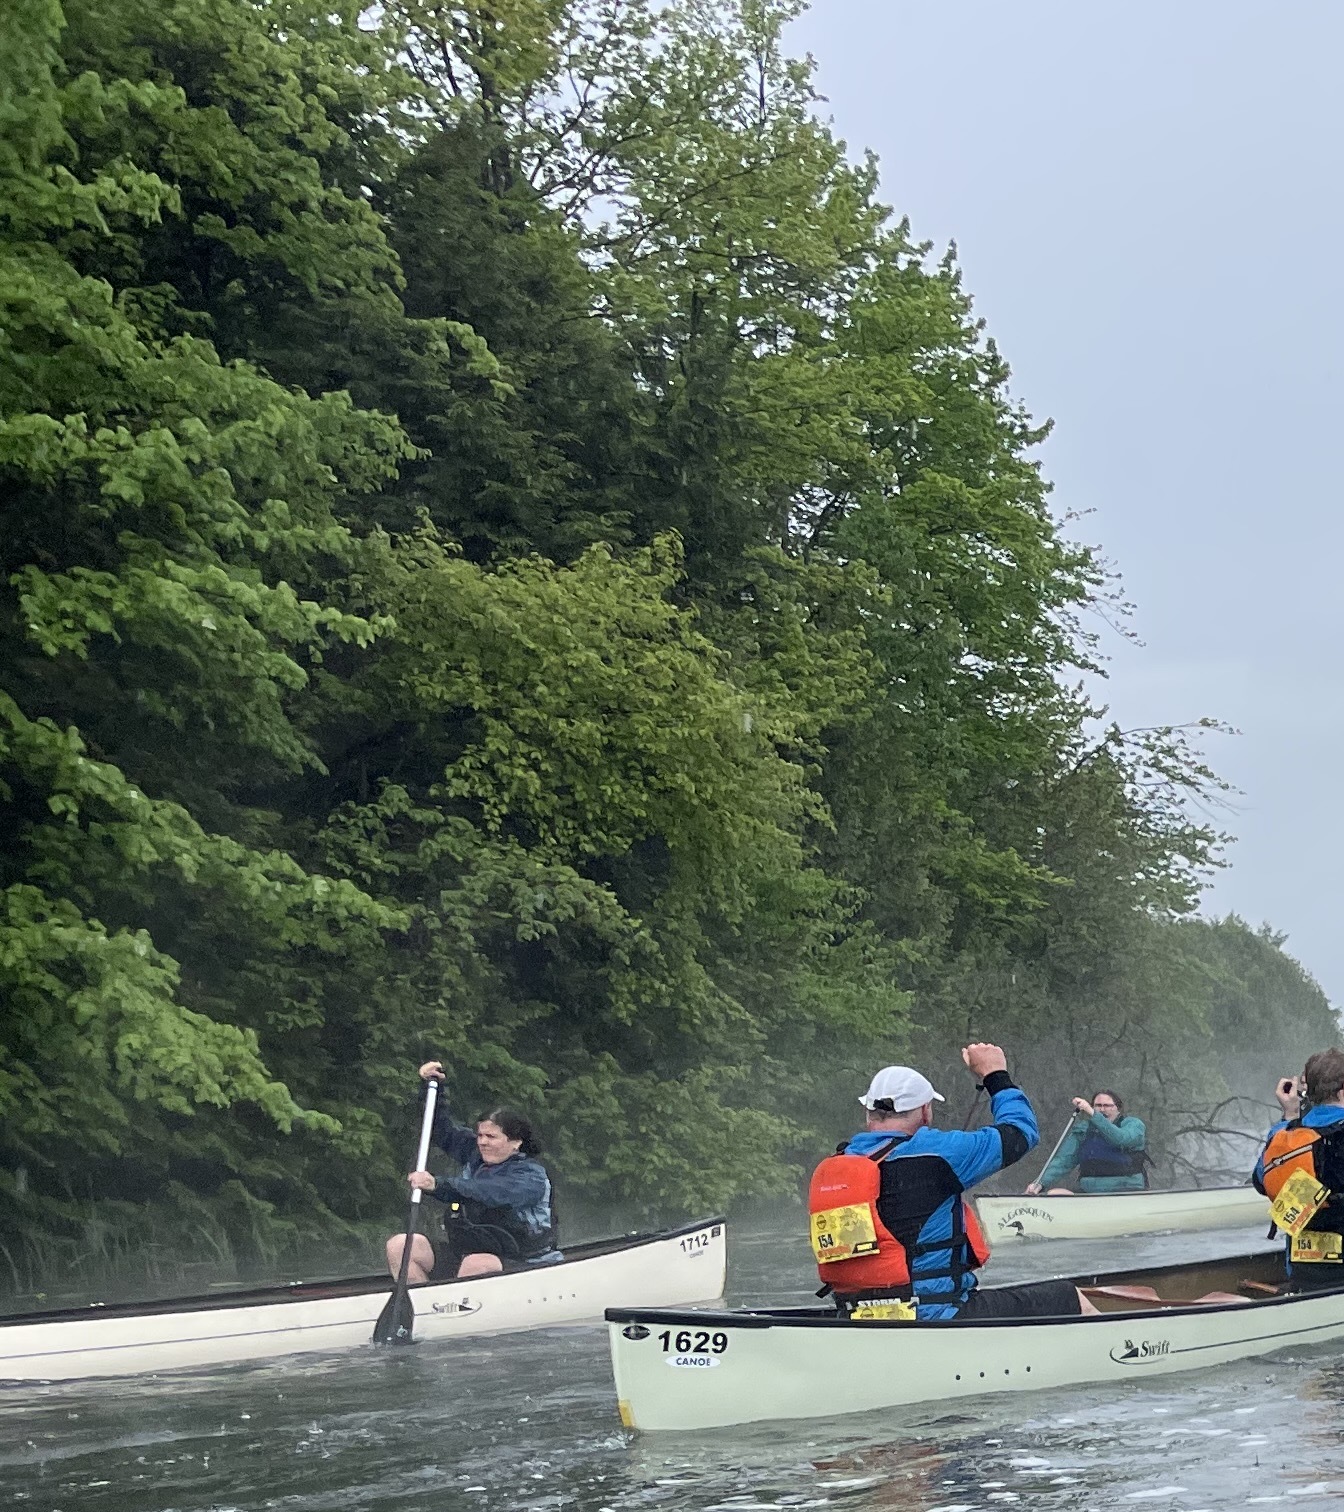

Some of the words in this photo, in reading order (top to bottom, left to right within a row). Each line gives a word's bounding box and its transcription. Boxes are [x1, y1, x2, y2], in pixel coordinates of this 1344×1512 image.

[997, 1206, 1054, 1230] ALGONQUIN
[1283, 1206, 1301, 1224] 154
[680, 1233, 709, 1252] 1712
[817, 1233, 834, 1249] 154
[658, 1330, 728, 1354] 1629
[1140, 1340, 1170, 1357] Swift
[676, 1357, 711, 1366] CANOE
